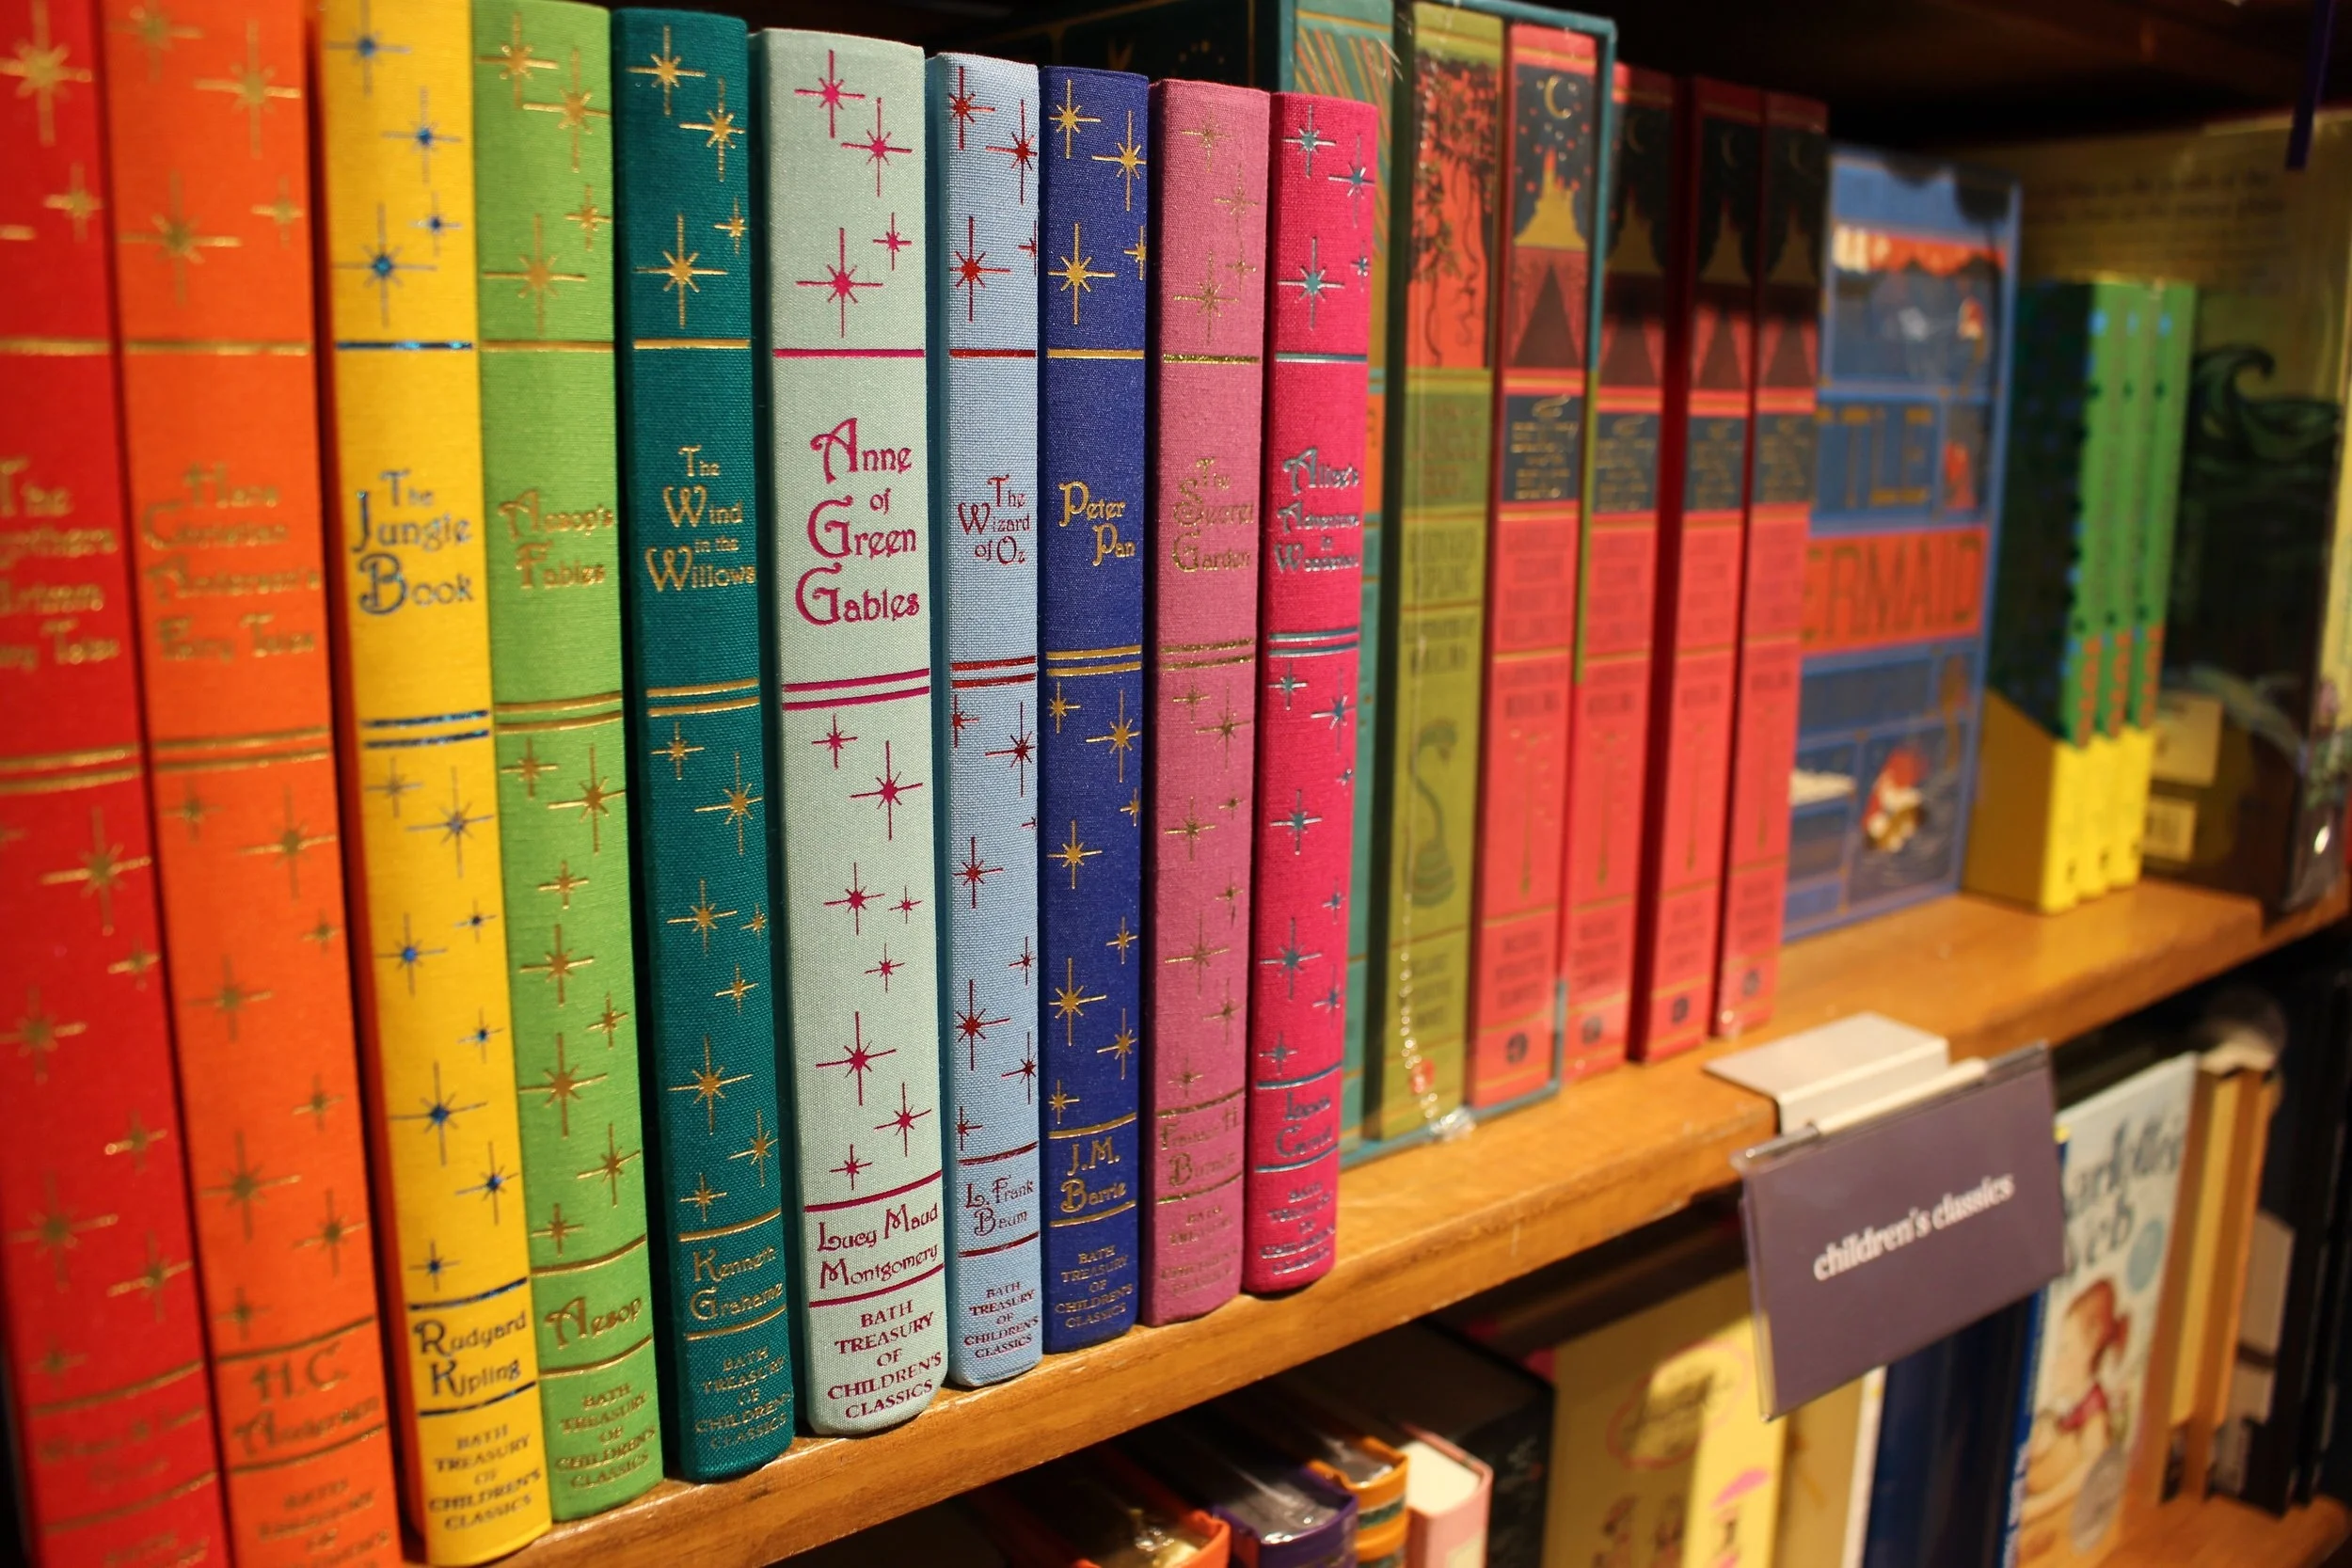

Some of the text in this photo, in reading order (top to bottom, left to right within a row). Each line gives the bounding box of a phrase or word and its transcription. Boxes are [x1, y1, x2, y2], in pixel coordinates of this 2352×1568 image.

[678, 444, 721, 478] The
[810, 418, 913, 484] Anne
[380, 469, 435, 507] The
[662, 484, 745, 528] Wind
[869, 487, 892, 515] of
[988, 474, 1025, 510] The
[1057, 480, 1126, 528] Peter
[351, 490, 471, 553] Jungle
[807, 495, 916, 560] Green
[958, 501, 1031, 536] Wizard
[694, 536, 739, 554] in the
[975, 535, 1025, 565] of Oz
[1091, 523, 1136, 566] Pan
[358, 553, 474, 616] Book
[644, 545, 757, 593] Willows
[795, 562, 920, 627] Gables
[1800, 532, 1985, 646] ERMAID
[992, 1174, 1035, 1205] Frank
[1060, 1178, 1127, 1213] Barrie
[817, 1202, 939, 1253] Lucy Maud
[974, 1208, 1027, 1237] Baum
[1813, 1174, 2015, 1282] children's classics
[691, 1244, 777, 1284] Kenneth
[819, 1243, 939, 1290] Montgomery
[1060, 1254, 1128, 1284] TREASURY
[1077, 1244, 1116, 1265] BATH
[689, 1283, 784, 1322] Grahame
[968, 1289, 1036, 1317] TREASURY
[987, 1280, 1021, 1299] BATH
[1055, 1283, 1134, 1315] CHILDREN'S
[1089, 1279, 1107, 1293] OF
[545, 1295, 644, 1351] Aesop
[834, 1311, 934, 1355] TREASURY
[860, 1299, 914, 1329] BATH
[963, 1316, 1039, 1347] CHILDREN'S
[996, 1312, 1014, 1326] OF
[1065, 1302, 1127, 1329] CLASSICS
[412, 1311, 528, 1360] Rudyard
[975, 1334, 1033, 1359] CLASSICS
[827, 1351, 942, 1401] CHILDREN'S
[876, 1347, 903, 1368] OF
[430, 1358, 522, 1398] Kipling
[845, 1379, 934, 1419] CLASSICS
